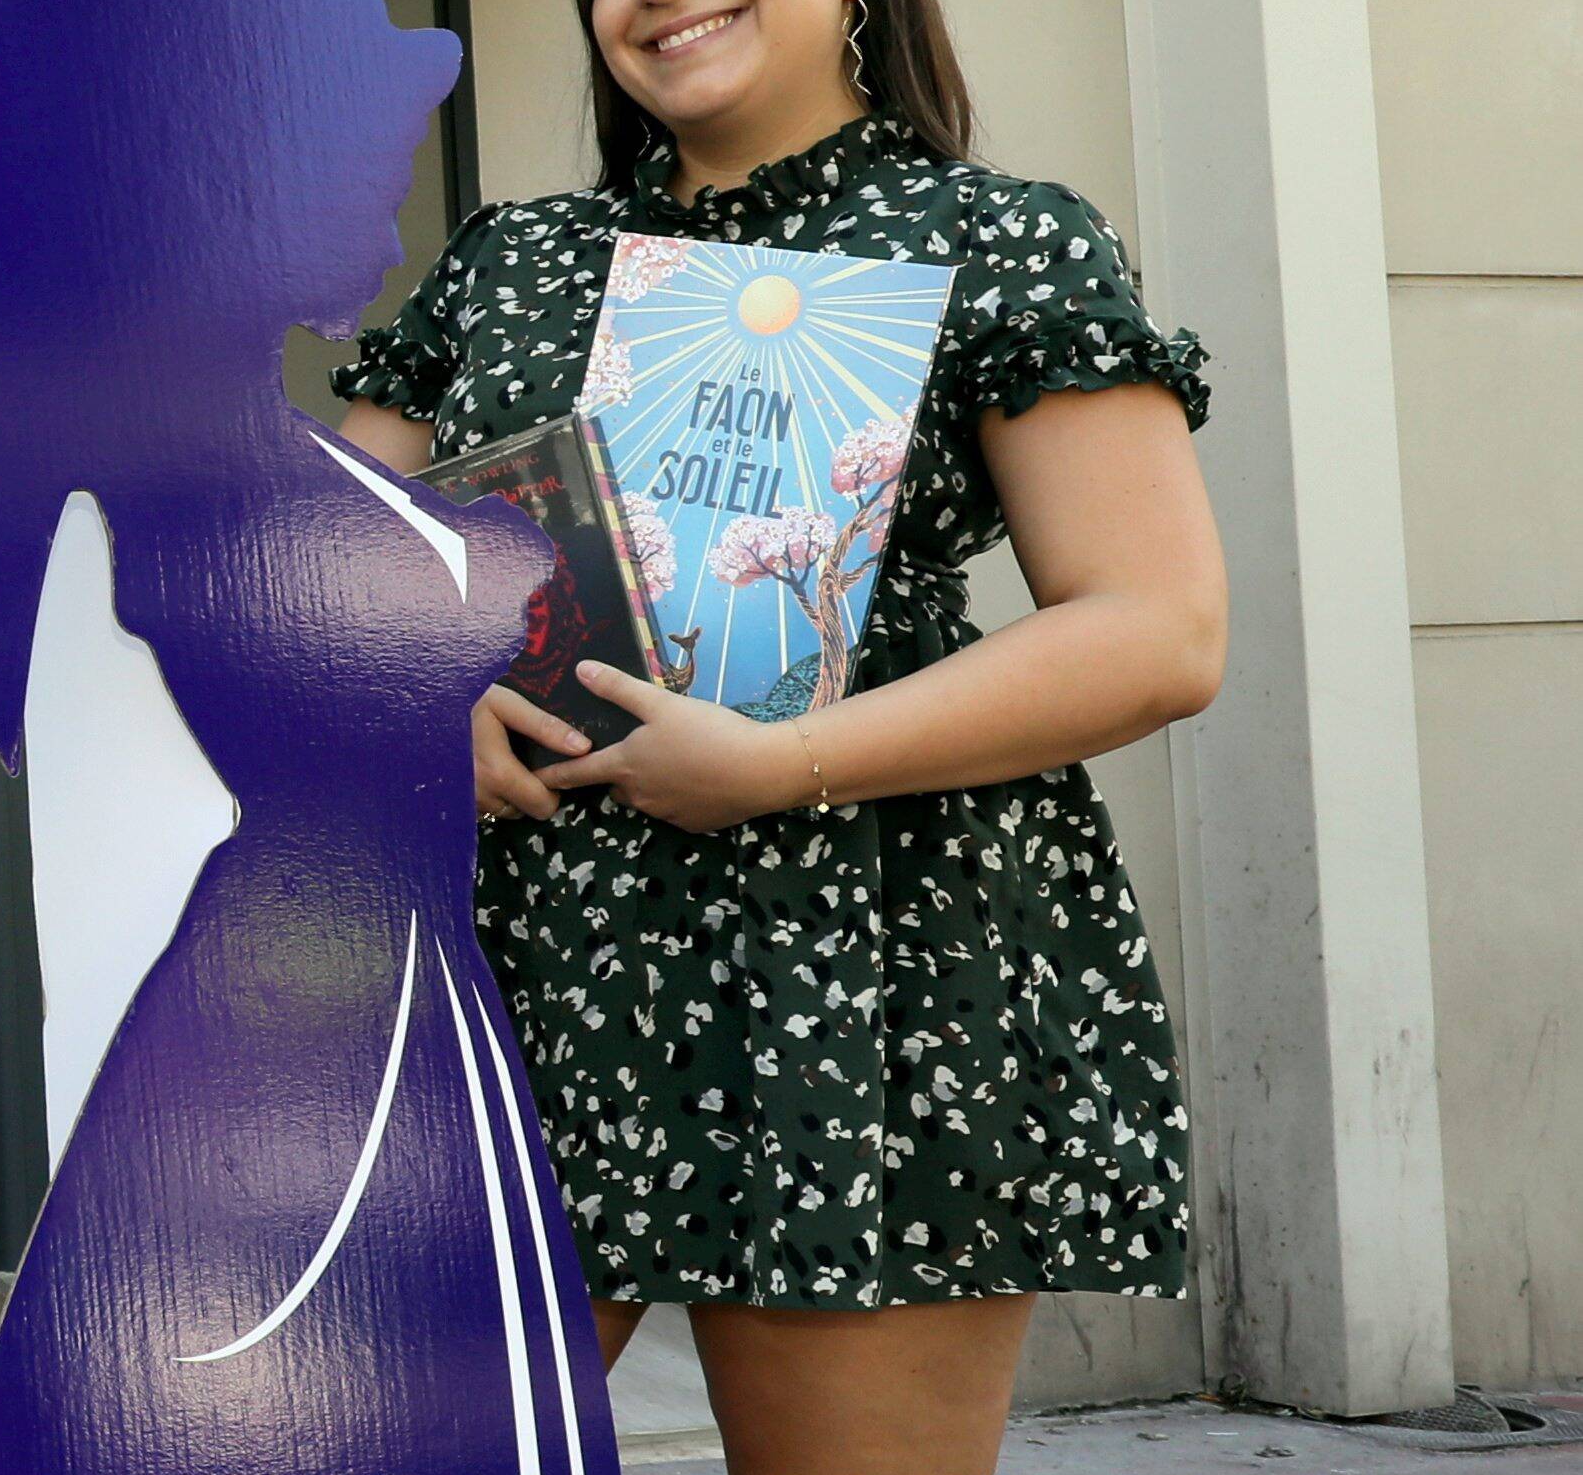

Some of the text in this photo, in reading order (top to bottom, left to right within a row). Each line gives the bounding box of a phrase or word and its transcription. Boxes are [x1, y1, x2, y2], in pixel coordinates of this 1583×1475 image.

[739, 363, 761, 382] Le
[689, 380, 796, 442] FAON
[712, 438, 753, 457] et le
[651, 450, 783, 519] SOLEIL
